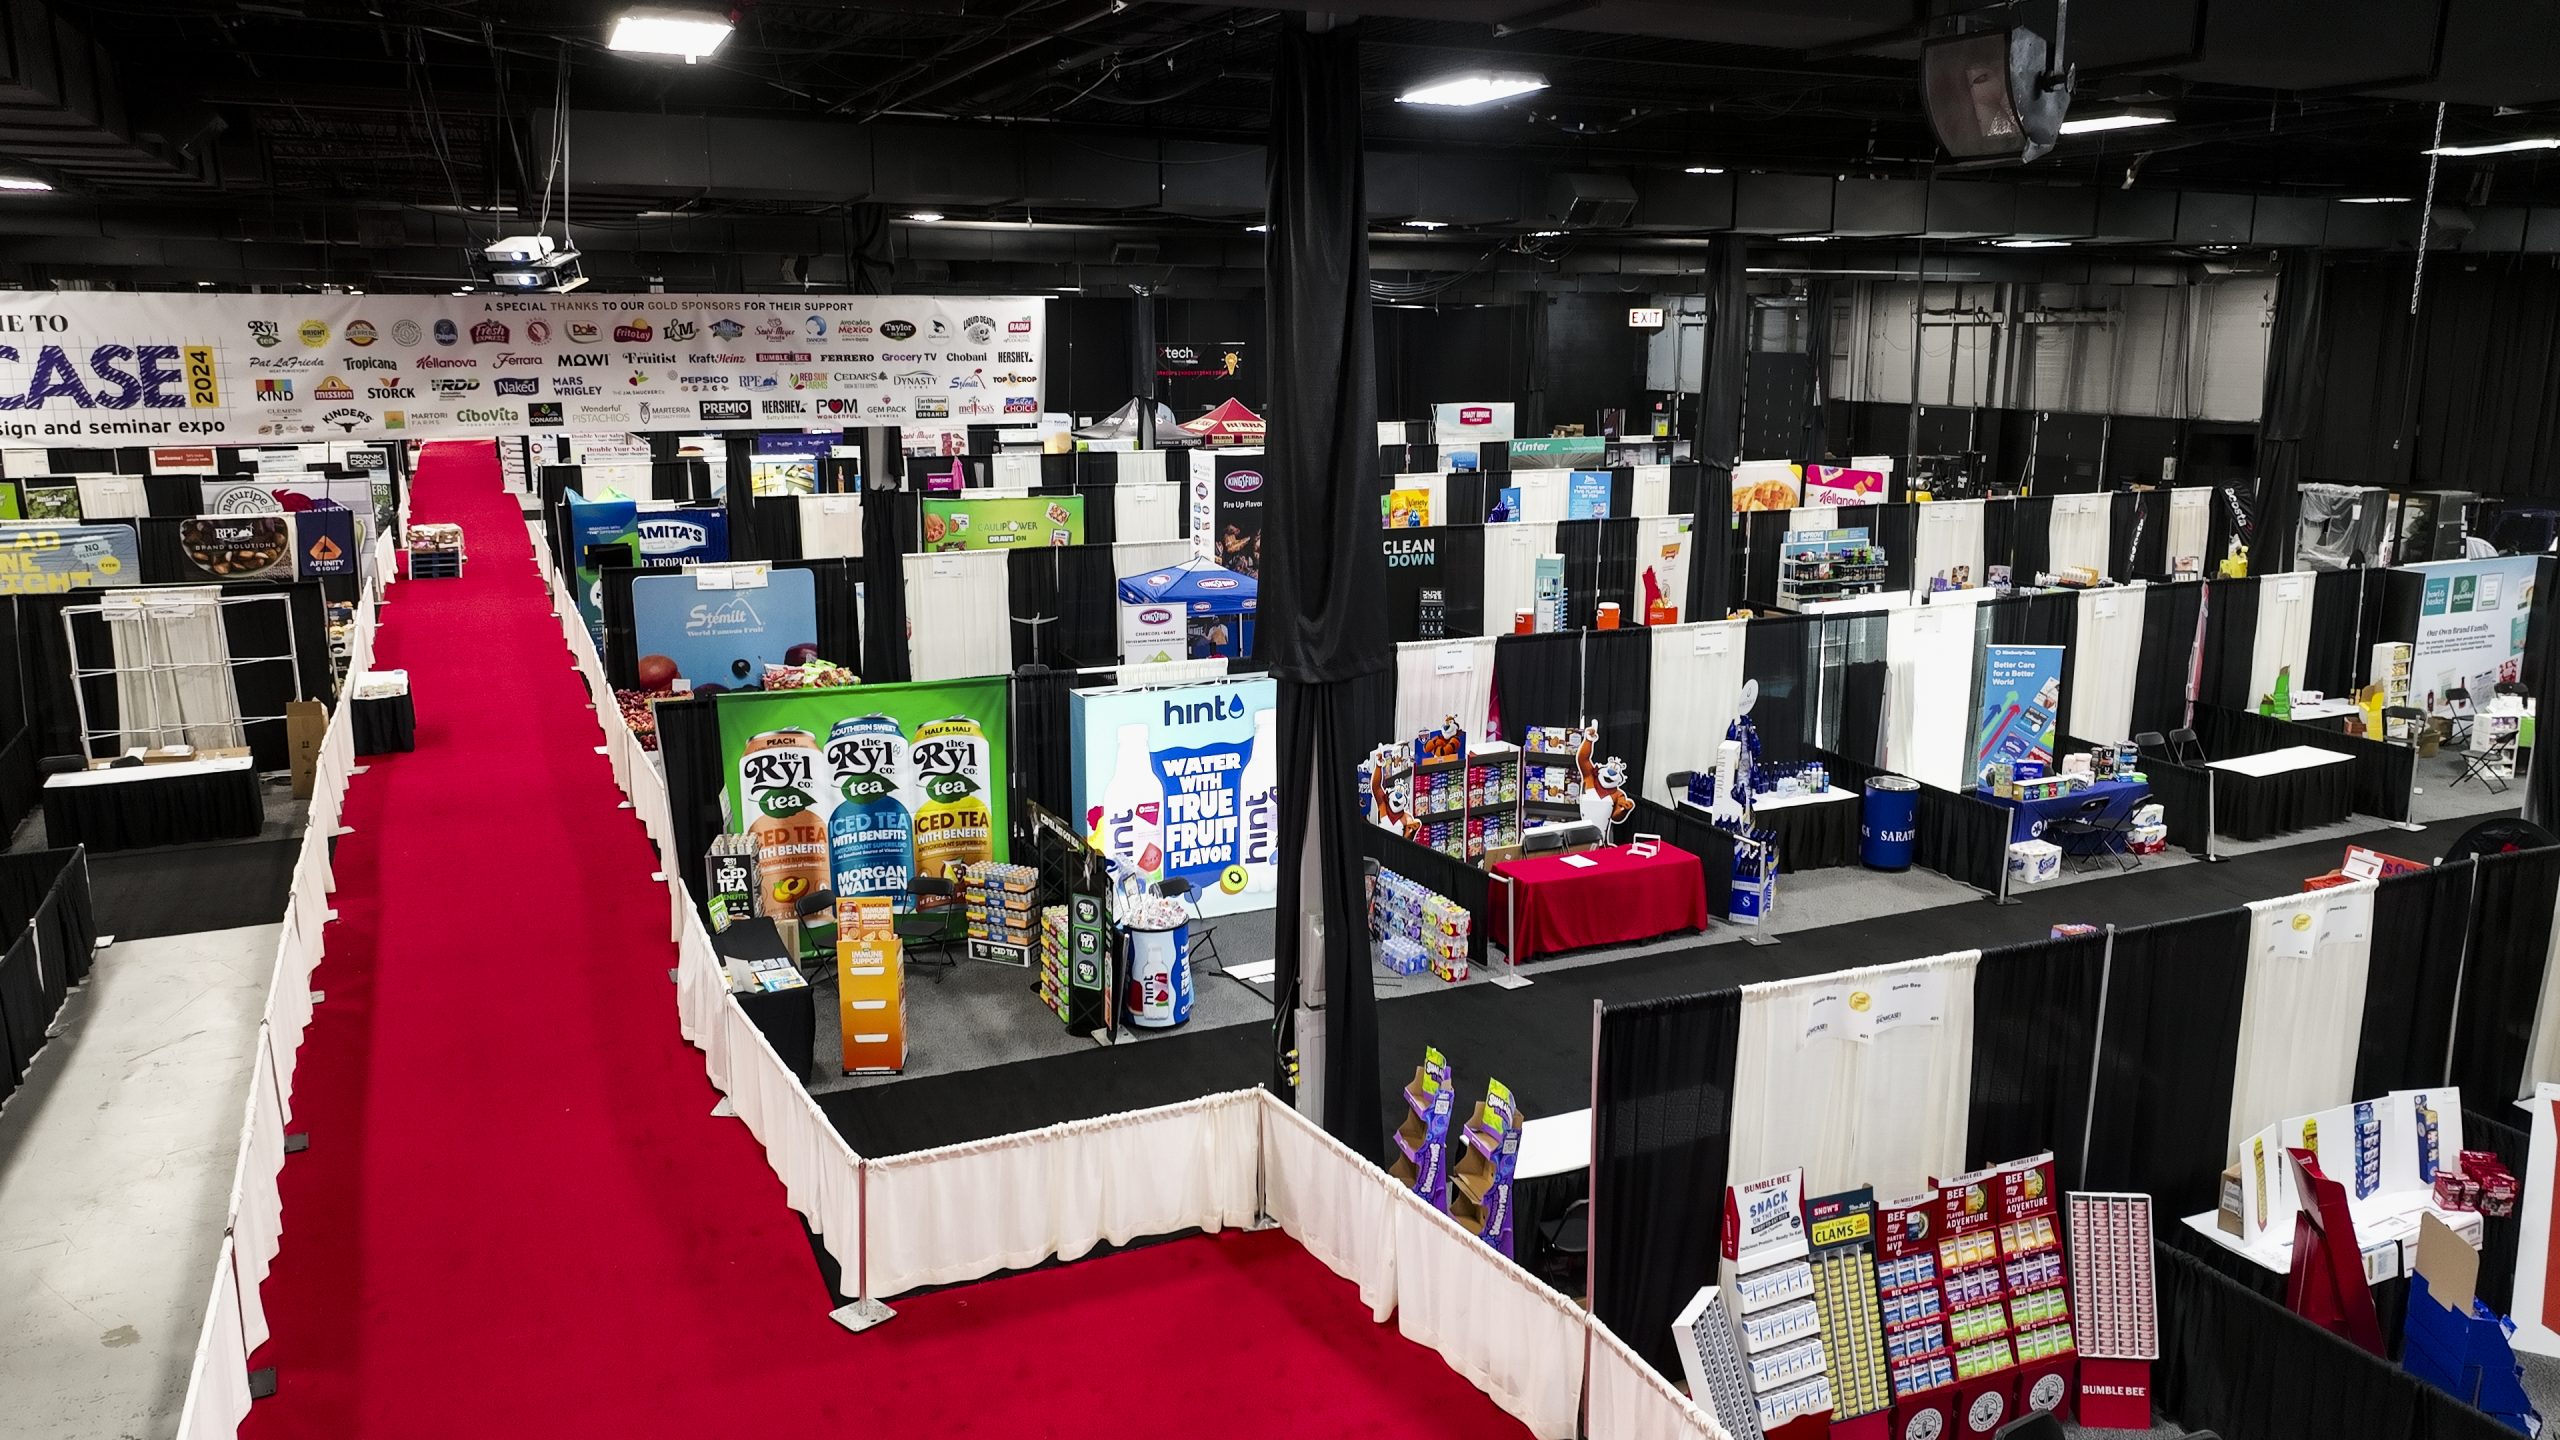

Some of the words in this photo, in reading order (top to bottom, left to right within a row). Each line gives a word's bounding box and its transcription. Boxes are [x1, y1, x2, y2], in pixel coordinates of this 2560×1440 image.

[484, 302, 492, 311] A
[496, 302, 547, 311] SPECIAL
[551, 302, 599, 311] THANKS
[602, 302, 618, 311] TO
[621, 302, 644, 311] OUR
[648, 301, 678, 310] GOLD
[681, 301, 741, 311] SPONSORS
[744, 301, 766, 311] FOR
[769, 302, 801, 311] THEIR
[804, 302, 854, 311] SUPPORT
[30, 315, 69, 333] TO
[963, 316, 980, 332] LIQUID
[980, 316, 997, 332] DEATH
[1631, 311, 1660, 324] EXIT
[572, 323, 598, 334] Dole
[838, 325, 873, 334] Mexico
[884, 323, 913, 334] Taylor
[1008, 323, 1030, 332] BADIA
[622, 351, 677, 364] Fruitist
[759, 353, 788, 362] BUMBLE
[794, 353, 809, 362] BEE
[820, 353, 875, 362] FERRERO
[881, 353, 922, 363] Grocery
[923, 353, 937, 361] TV
[946, 352, 987, 362] Chobani
[1165, 346, 1194, 359] tech
[249, 357, 270, 368] Pat
[273, 356, 325, 368] LaFrieda
[343, 356, 398, 371] Tropicana
[416, 354, 477, 369] Kellanova
[493, 352, 543, 369] Ferrara
[191, 351, 214, 404] 2024
[552, 376, 583, 386] MARS
[739, 375, 763, 388] RPE
[800, 372, 812, 381] RED
[813, 372, 828, 381] SUN
[834, 372, 877, 381] CEDAR'S
[893, 374, 938, 386] DYNASTY
[993, 376, 1008, 384] TOP
[1016, 375, 1037, 383] CROP
[368, 387, 416, 399] STORCK
[497, 380, 536, 394] Naked
[553, 386, 602, 396] WRIGLEY
[256, 391, 294, 401] KIND
[580, 405, 622, 413] Wonderful
[702, 402, 749, 413] PREMIO
[762, 400, 800, 414] HERSHEY
[867, 405, 884, 413] GEM
[886, 405, 907, 413] PACK
[456, 407, 519, 422] CiboVita
[572, 413, 630, 424] PISTACHIOS
[44, 420, 81, 434] and
[89, 419, 171, 434] seminar
[179, 421, 225, 435] expo
[1226, 421, 1264, 430] BUBBA
[1512, 442, 1550, 452] Kinter
[1227, 474, 1260, 488] KINGSFORD
[223, 489, 268, 512] naturipe
[215, 527, 238, 540] RPE
[228, 541, 277, 549] SOLUTIONS
[1382, 538, 1435, 555] CLEAN
[309, 559, 344, 567] AFFINITY
[1388, 553, 1435, 567] DOWN
[685, 604, 746, 629] Stemilt
[743, 626, 764, 634] Fruit
[2427, 628, 2438, 636] Our
[2439, 627, 2452, 635] Own
[2452, 625, 2469, 634] Brand
[2470, 623, 2488, 633] Family
[1993, 661, 2017, 669] Better
[2017, 661, 2036, 669] Care
[1164, 695, 1227, 726] hint
[831, 724, 873, 737] SOUTHERN
[873, 723, 897, 733] SWEET
[925, 727, 943, 736] HALF
[766, 738, 796, 746] PEACH
[861, 738, 881, 747] the
[946, 739, 965, 748] the
[779, 752, 799, 761] the
[827, 741, 895, 781] Ryl
[912, 742, 978, 781] Ryl
[1162, 752, 1241, 777] WATER
[744, 754, 813, 795] Ryl
[848, 780, 884, 797] tea
[934, 780, 968, 796] tea
[1179, 773, 1223, 793] WITH
[767, 795, 803, 811] tea
[1167, 788, 1234, 823] TRUE
[830, 813, 871, 838] ICED
[875, 812, 909, 830] TEA
[914, 813, 955, 835] ICED
[958, 811, 989, 828] TEA
[1245, 791, 1268, 864] hint
[832, 831, 857, 848] WITH
[859, 829, 907, 842] BENEFITS
[917, 831, 942, 845] WITH
[943, 827, 987, 839] BENEFITS
[1166, 815, 1238, 852] FRUIT
[1170, 845, 1232, 869] FLAVOR
[717, 867, 747, 879] ICED
[837, 866, 907, 884] MORGAN
[717, 879, 748, 892] TEA
[838, 878, 907, 897] WALLEN
[851, 957, 884, 965] SUPPORT
[1143, 975, 1154, 1005] hint
[1744, 1178, 1775, 1194] BUMBLE
[1776, 1174, 1792, 1185] BEE
[2005, 1172, 2023, 1185] BEE
[1946, 1187, 1965, 1200] BEE
[2006, 1195, 2024, 1204] FLAVOR
[1749, 1190, 1788, 1218] SNACK
[1813, 1203, 1839, 1216] SNOW'S
[2006, 1197, 2048, 1214] ADVENTURE
[1752, 1216, 1762, 1225] ON
[1762, 1212, 1773, 1222] THE
[1887, 1210, 1906, 1223] BEE
[1946, 1210, 1965, 1220] FLAVOR
[1946, 1212, 1988, 1229] ADVENTURE
[1815, 1225, 1854, 1243] CLAMS
[1886, 1241, 1903, 1252] MVP
[2082, 1384, 2124, 1396] BUMBLE
[2125, 1386, 2146, 1397] BEE
